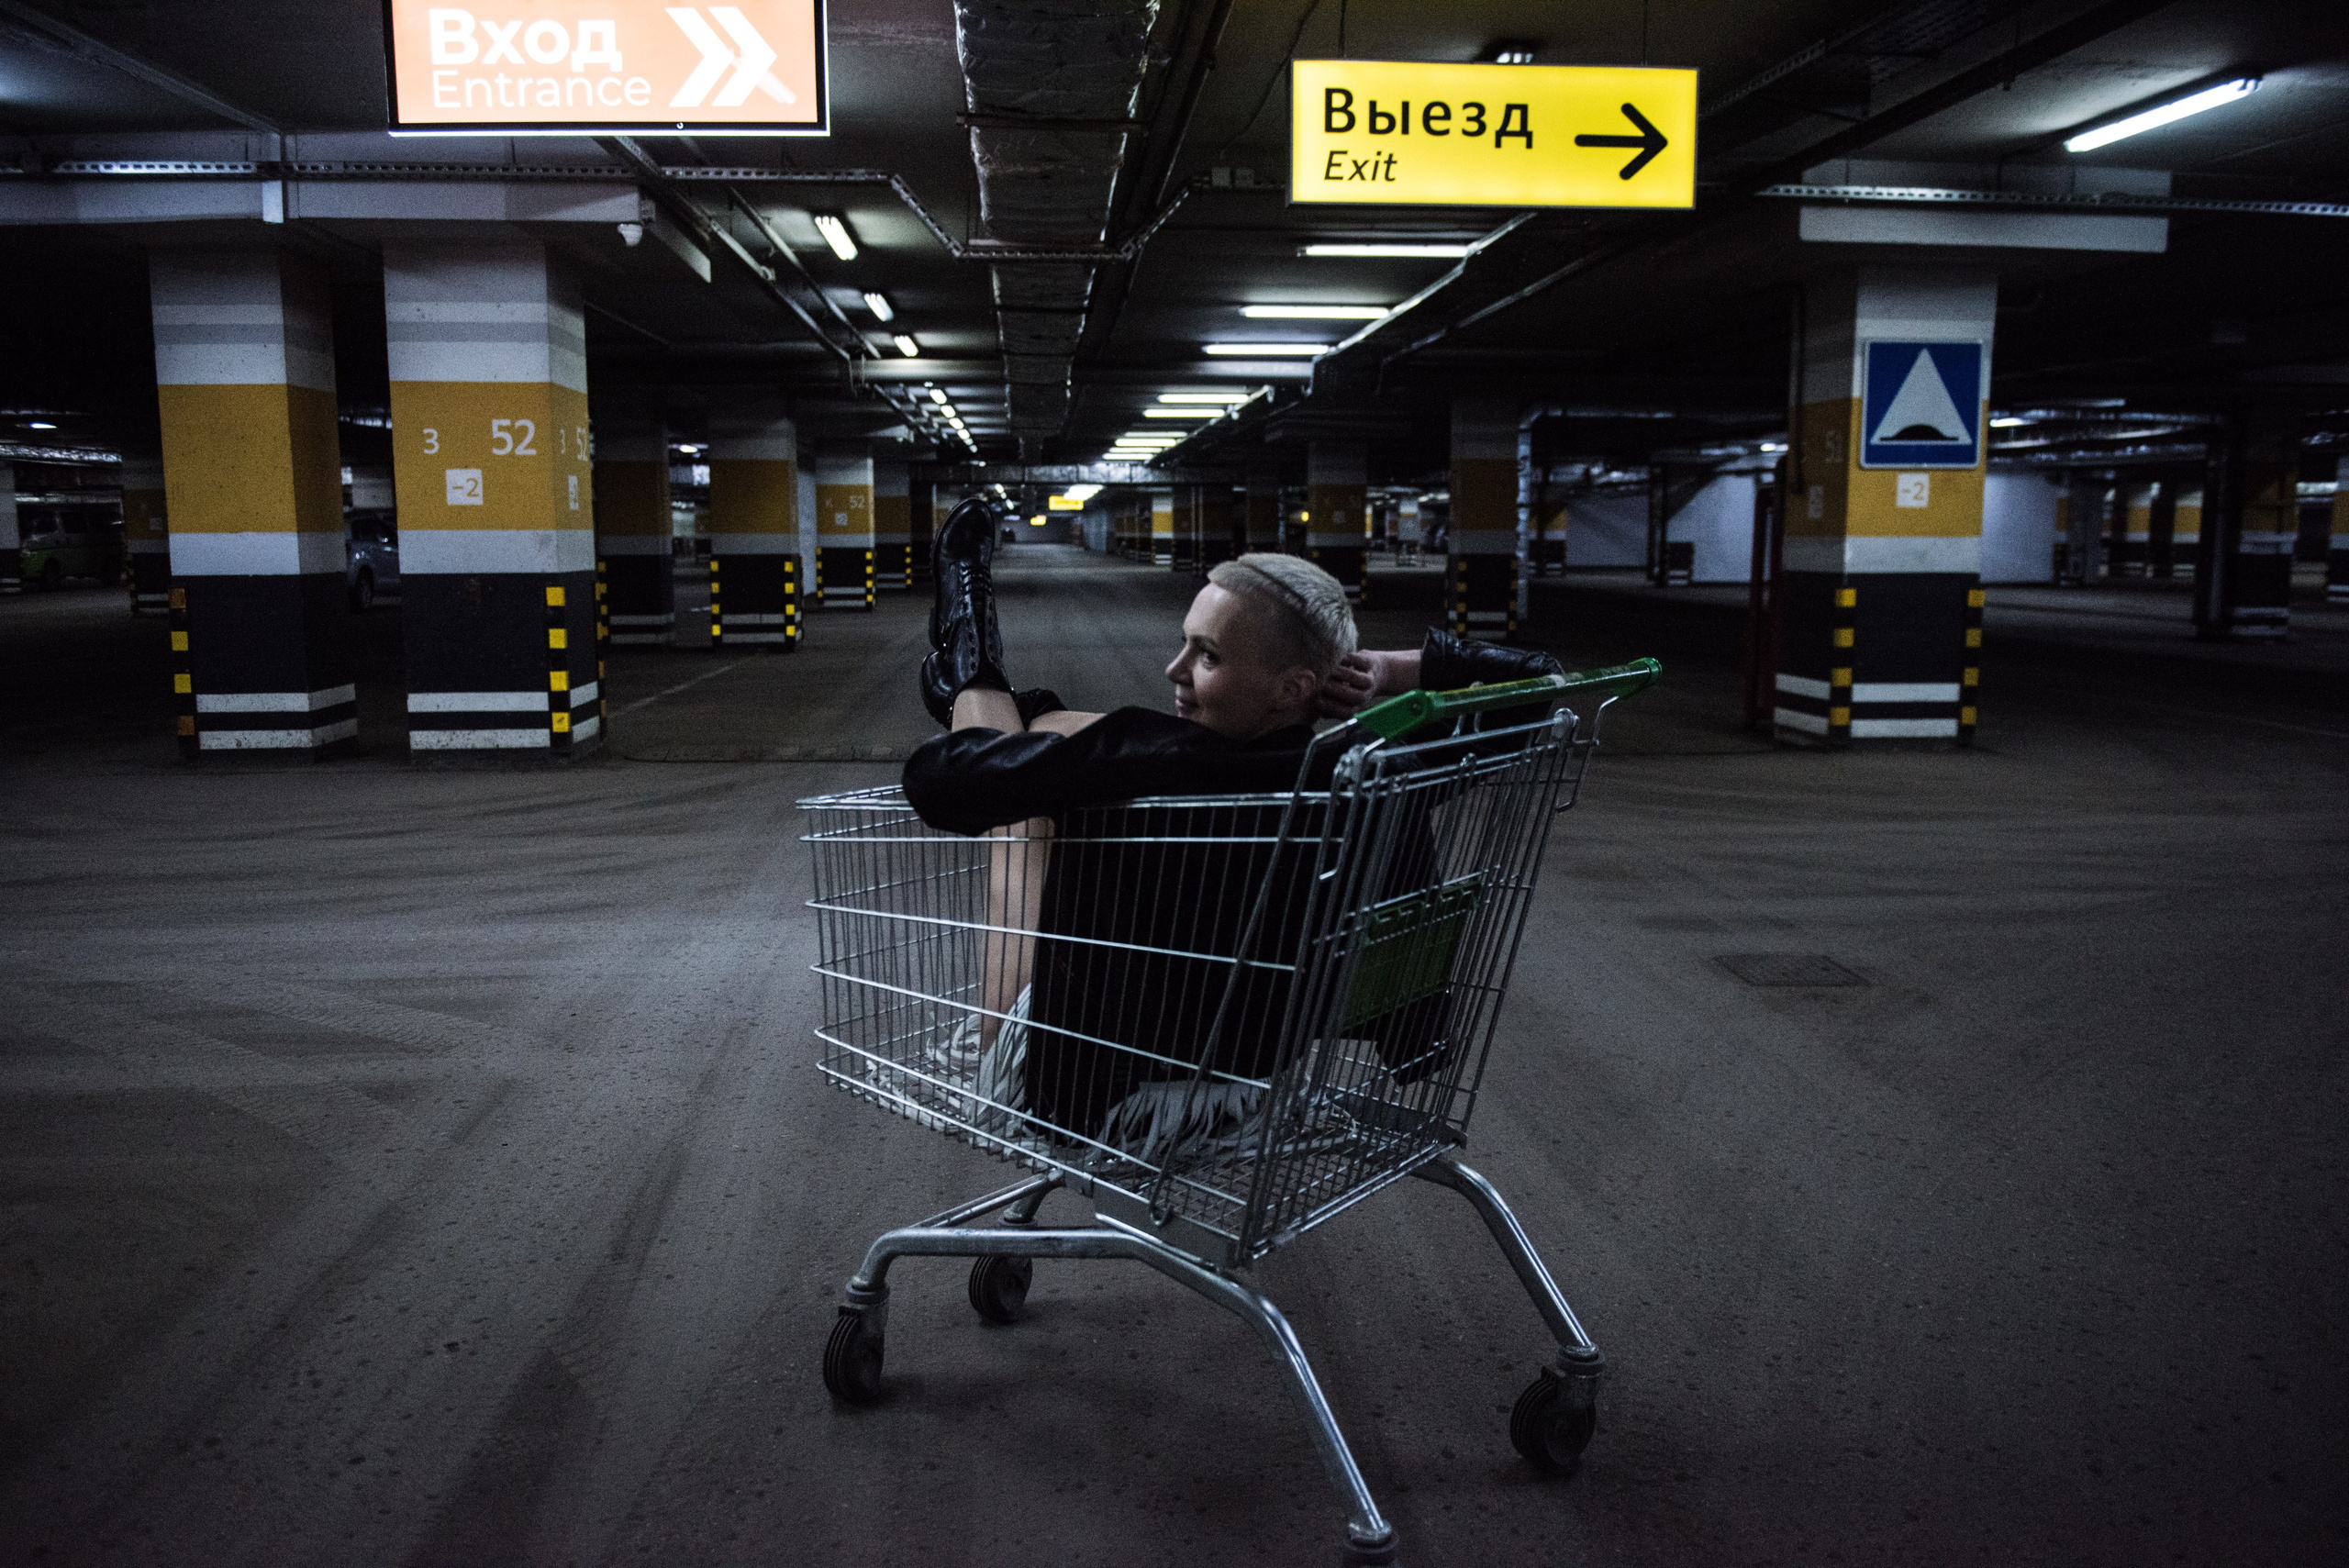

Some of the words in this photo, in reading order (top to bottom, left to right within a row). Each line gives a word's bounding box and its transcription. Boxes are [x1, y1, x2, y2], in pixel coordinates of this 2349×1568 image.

[429, 7, 623, 72] Вход
[432, 70, 651, 108] Entrance
[1324, 87, 1533, 149] Выезд
[1324, 150, 1397, 182] Exit
[422, 428, 440, 455] 3
[491, 418, 538, 456] 52
